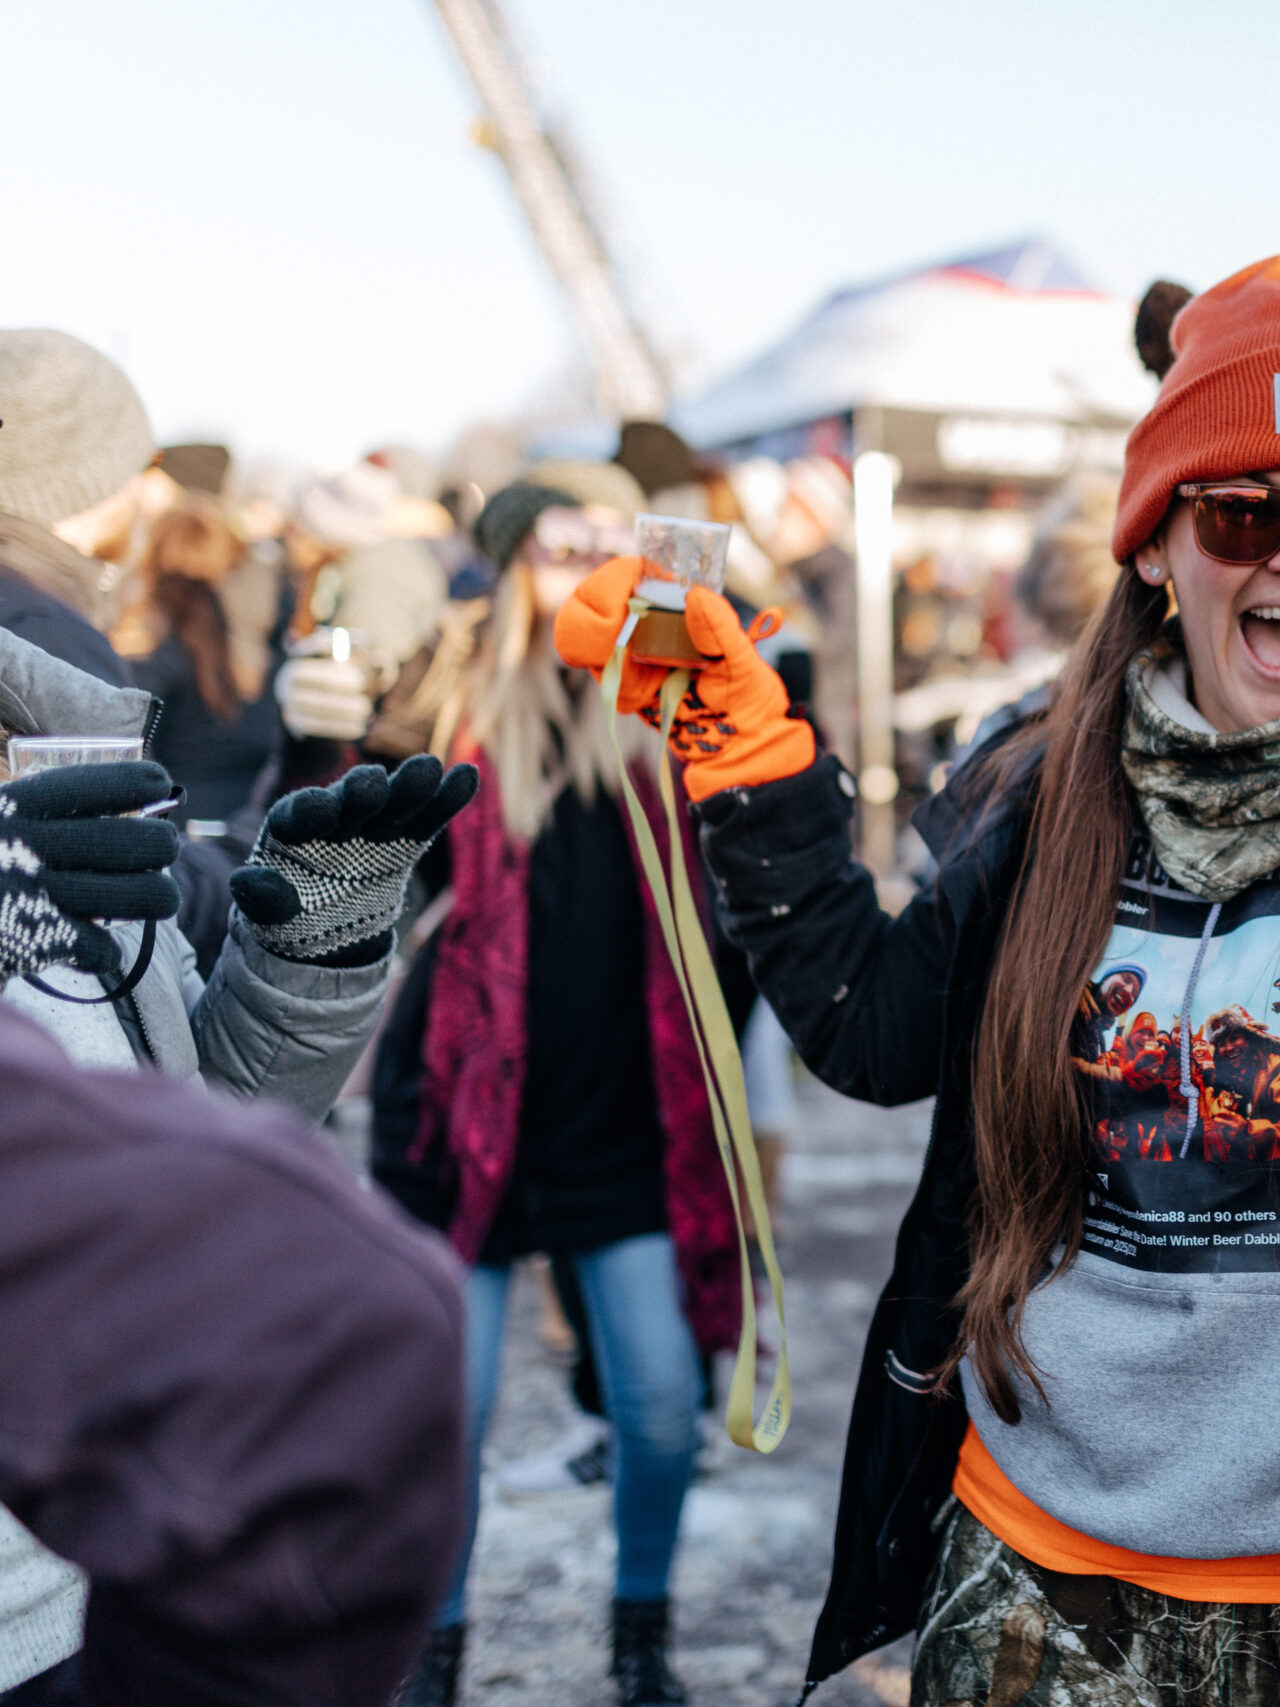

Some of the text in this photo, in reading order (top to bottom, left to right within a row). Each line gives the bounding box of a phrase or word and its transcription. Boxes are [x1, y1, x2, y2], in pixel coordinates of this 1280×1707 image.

[1188, 1211, 1211, 1223] and
[1214, 1211, 1231, 1222] 90
[1235, 1210, 1277, 1221] others
[1140, 1233, 1167, 1246] Date!
[1169, 1234, 1210, 1247] Winter
[1213, 1234, 1242, 1246] Beer
